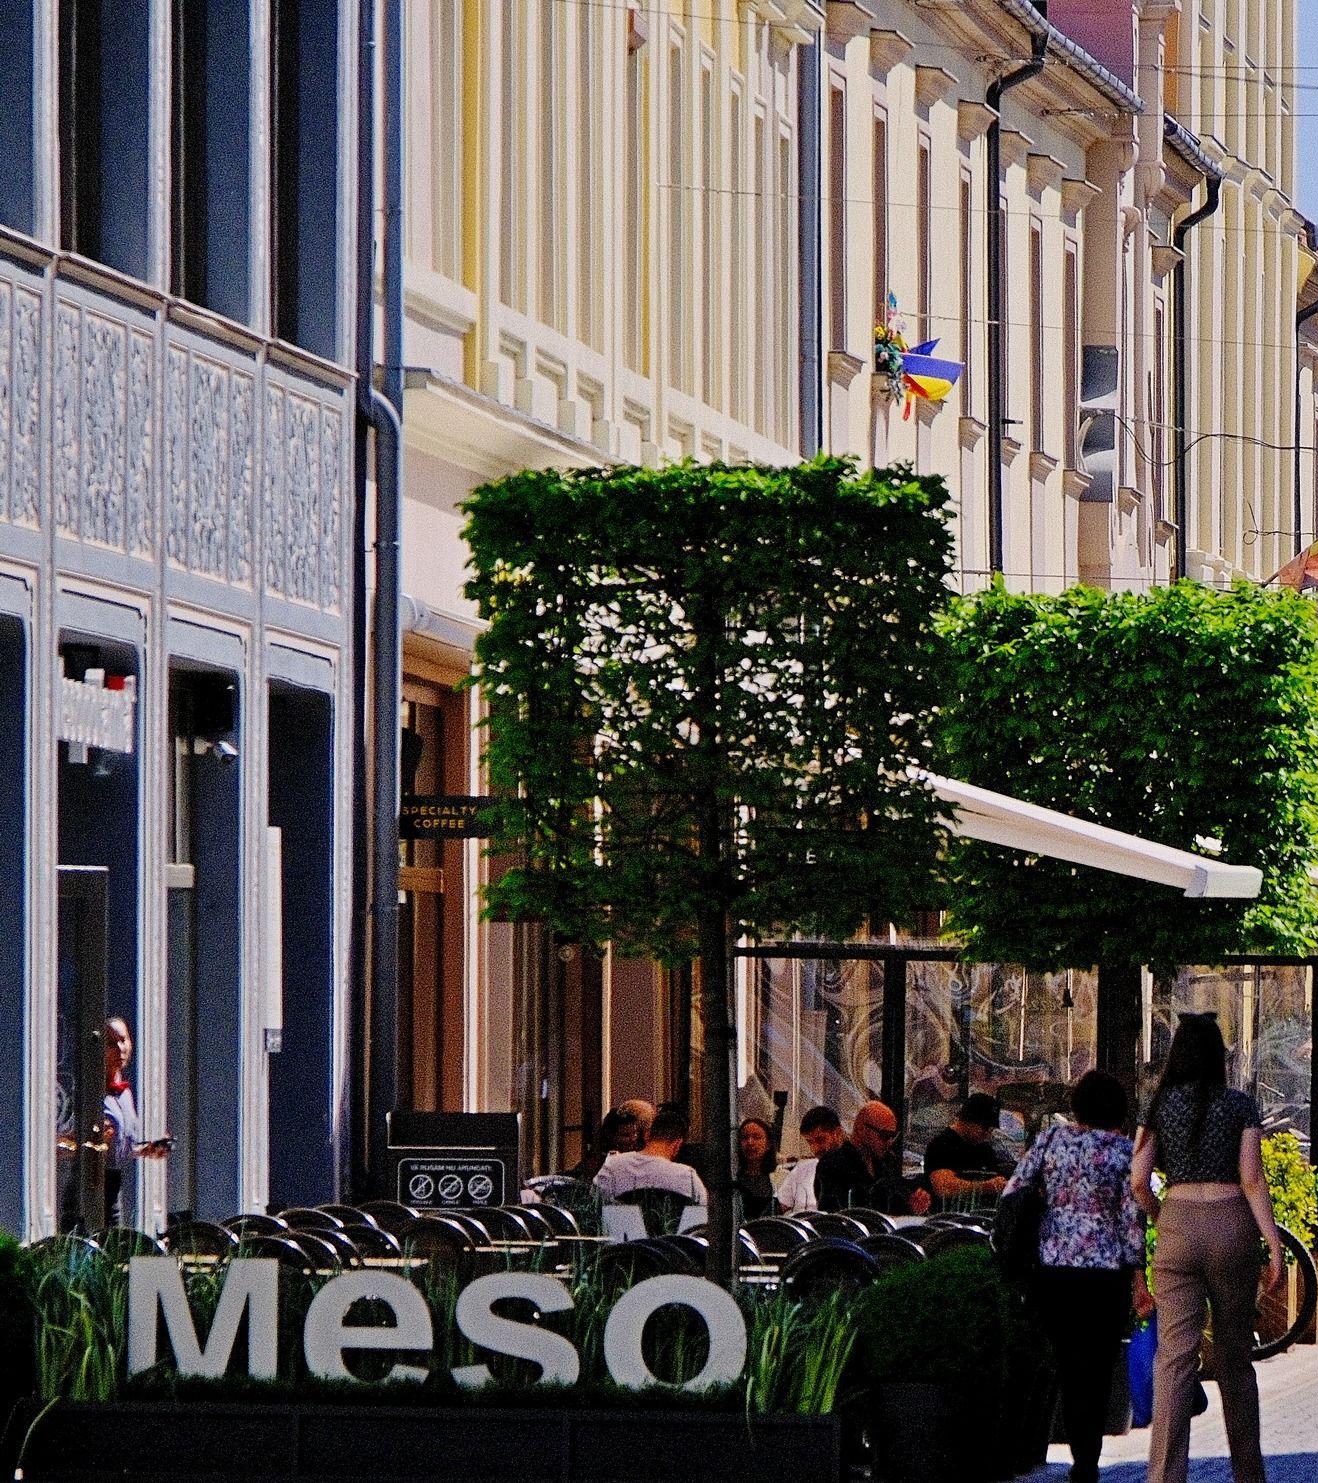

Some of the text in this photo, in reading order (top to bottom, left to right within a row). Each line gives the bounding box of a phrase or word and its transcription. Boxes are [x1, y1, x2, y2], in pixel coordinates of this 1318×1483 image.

[402, 806, 476, 816] SPECIALTY
[414, 819, 465, 829] COFFEE
[127, 1255, 748, 1393] Meso
